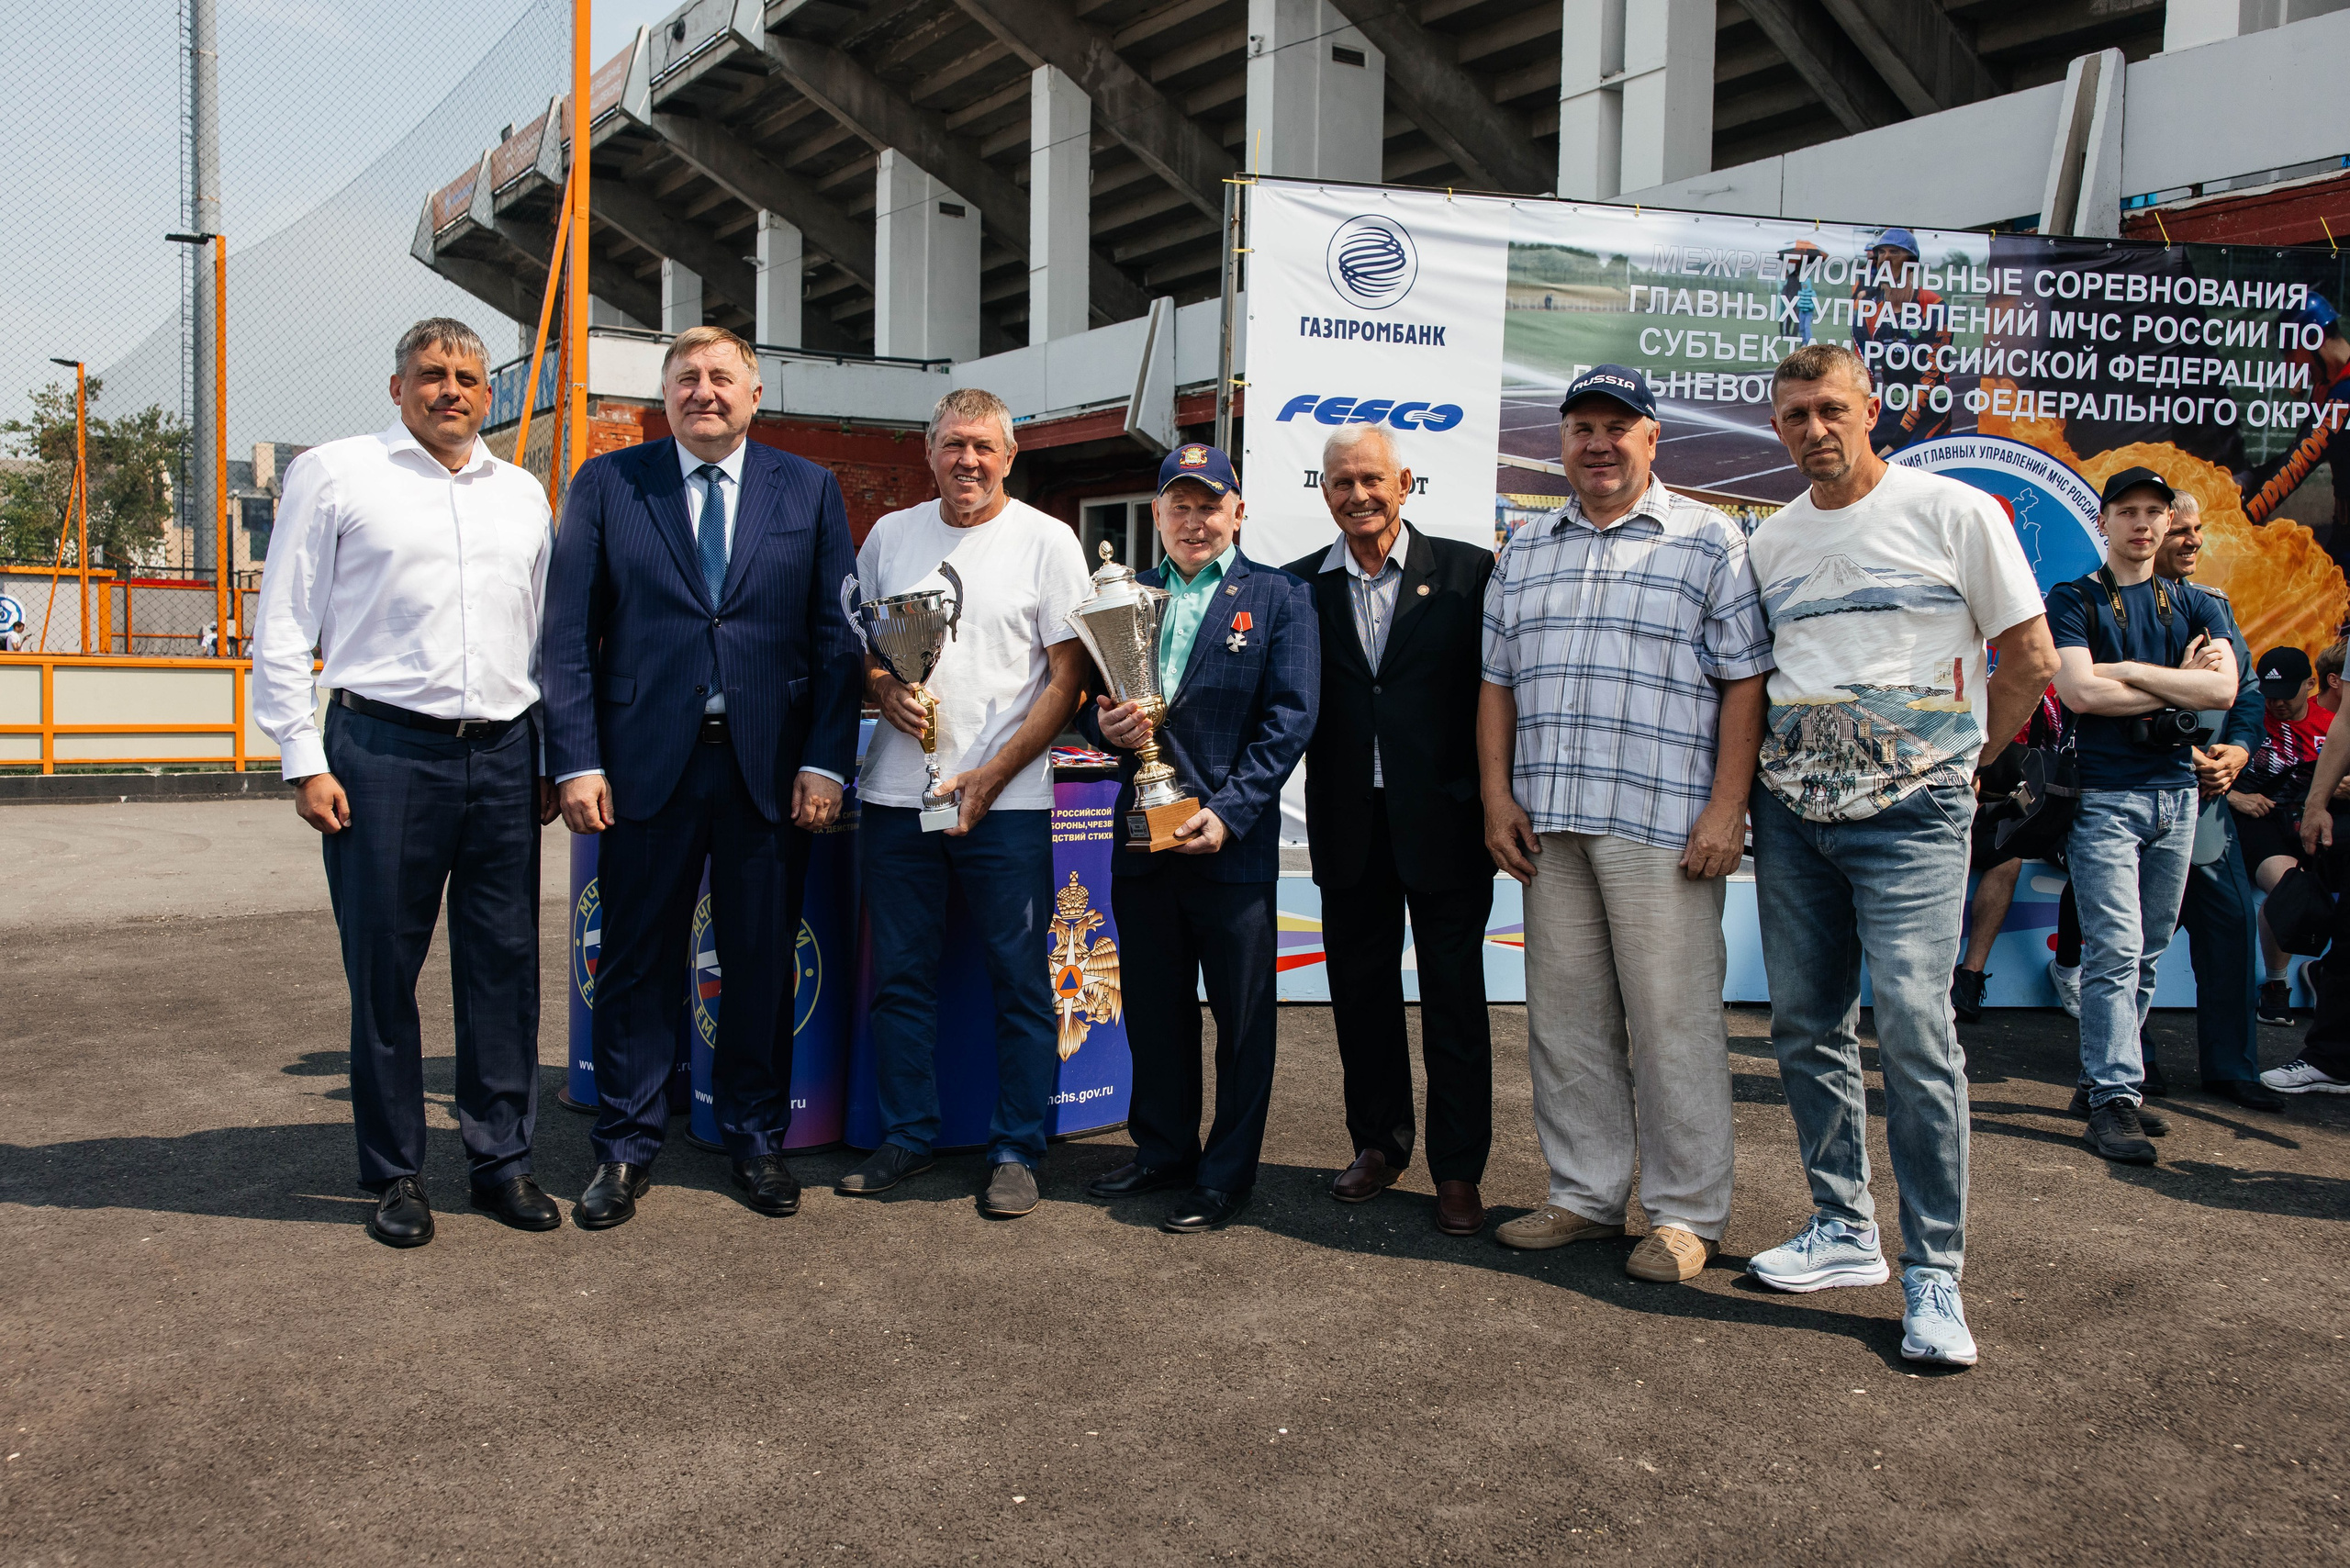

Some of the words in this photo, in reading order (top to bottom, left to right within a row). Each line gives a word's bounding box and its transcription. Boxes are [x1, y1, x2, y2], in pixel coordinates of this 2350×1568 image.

[1652, 244, 2023, 296] МЕЖРЕГИОНАЛЬНЫЕ
[2033, 270, 2308, 310] СОРЕВНОВАНИЯ
[1300, 316, 1447, 346] ГАЗПРОМБАНК
[1628, 285, 1801, 323] ГЛАВНЫХ
[1810, 296, 2039, 337] УПРАВЛЕНИЙ
[2050, 309, 2122, 342] МЧС
[2132, 315, 2268, 348] РОССИИ
[2278, 322, 2324, 351] ПО
[1639, 328, 1852, 364] СУБЪЕКТ
[1864, 341, 2098, 380] РОССИЙСКОЙ
[2109, 354, 2310, 393] ФЕДЕРАЦИИ
[1572, 375, 1636, 392] RUSSIA
[1275, 394, 1464, 431] FESCO
[1964, 387, 2237, 426] ФЕДЕРАЛЬНОГО
[2246, 399, 2350, 431] ОКРУГ
[1924, 444, 1975, 465] ГЛАВНЫХ
[1979, 445, 2048, 477] УПРАВЛЕНИЙ
[2046, 469, 2069, 491] МЧС
[2066, 485, 2099, 524] РОССИИ
[2158, 589, 2167, 608] Nikon
[1051, 820, 1113, 830] БОРОНЫ,ЧРЕЗВ
[1057, 807, 1112, 817] РОССИЙСКОЙ
[1052, 832, 1086, 843] ДСТВИЙ
[1088, 832, 1113, 840] СТИХИ
